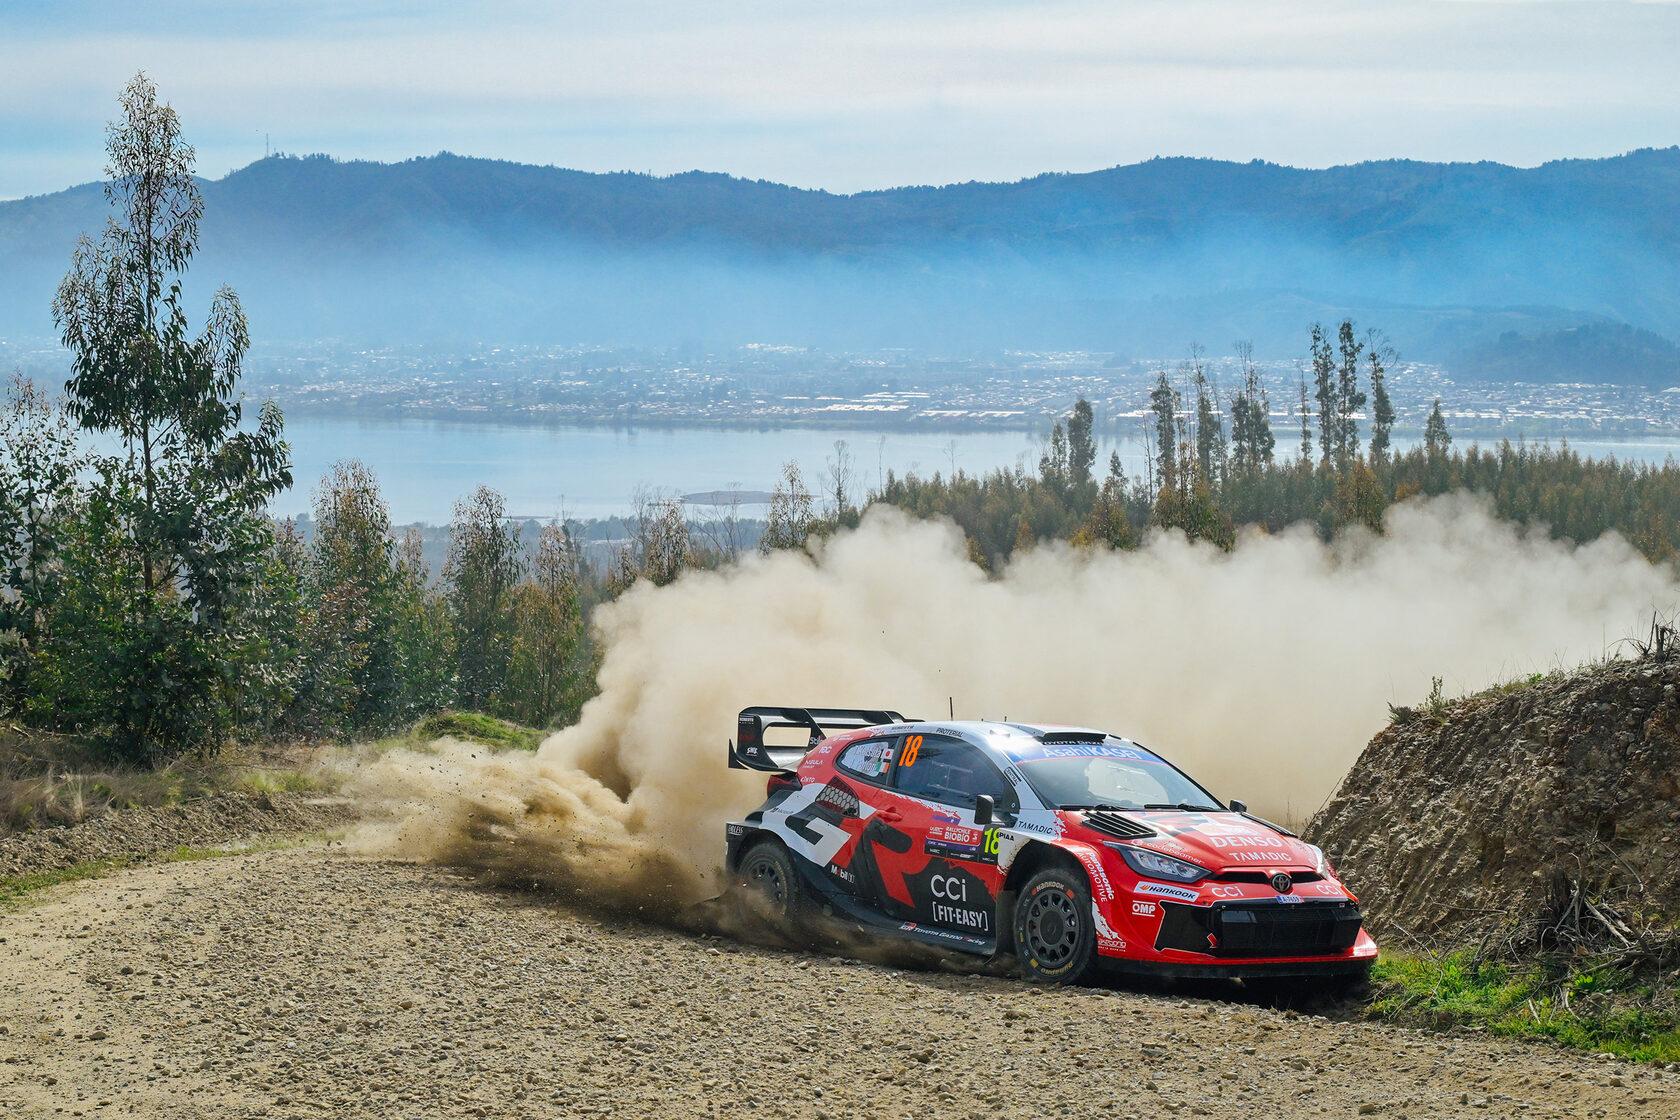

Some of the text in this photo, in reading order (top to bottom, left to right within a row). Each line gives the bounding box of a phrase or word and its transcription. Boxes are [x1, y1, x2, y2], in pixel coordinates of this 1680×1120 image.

[899, 735, 923, 767] 18
[1019, 821, 1053, 834] TAMADIC
[984, 827, 999, 855] 18
[1000, 832, 1015, 841] PIAA
[1210, 837, 1282, 848] DENSO
[1229, 852, 1292, 862] TAMADIC
[1077, 853, 1107, 902] AUTOMOTIVE
[1086, 852, 1115, 900] Panasonic
[1132, 903, 1156, 914] OMP
